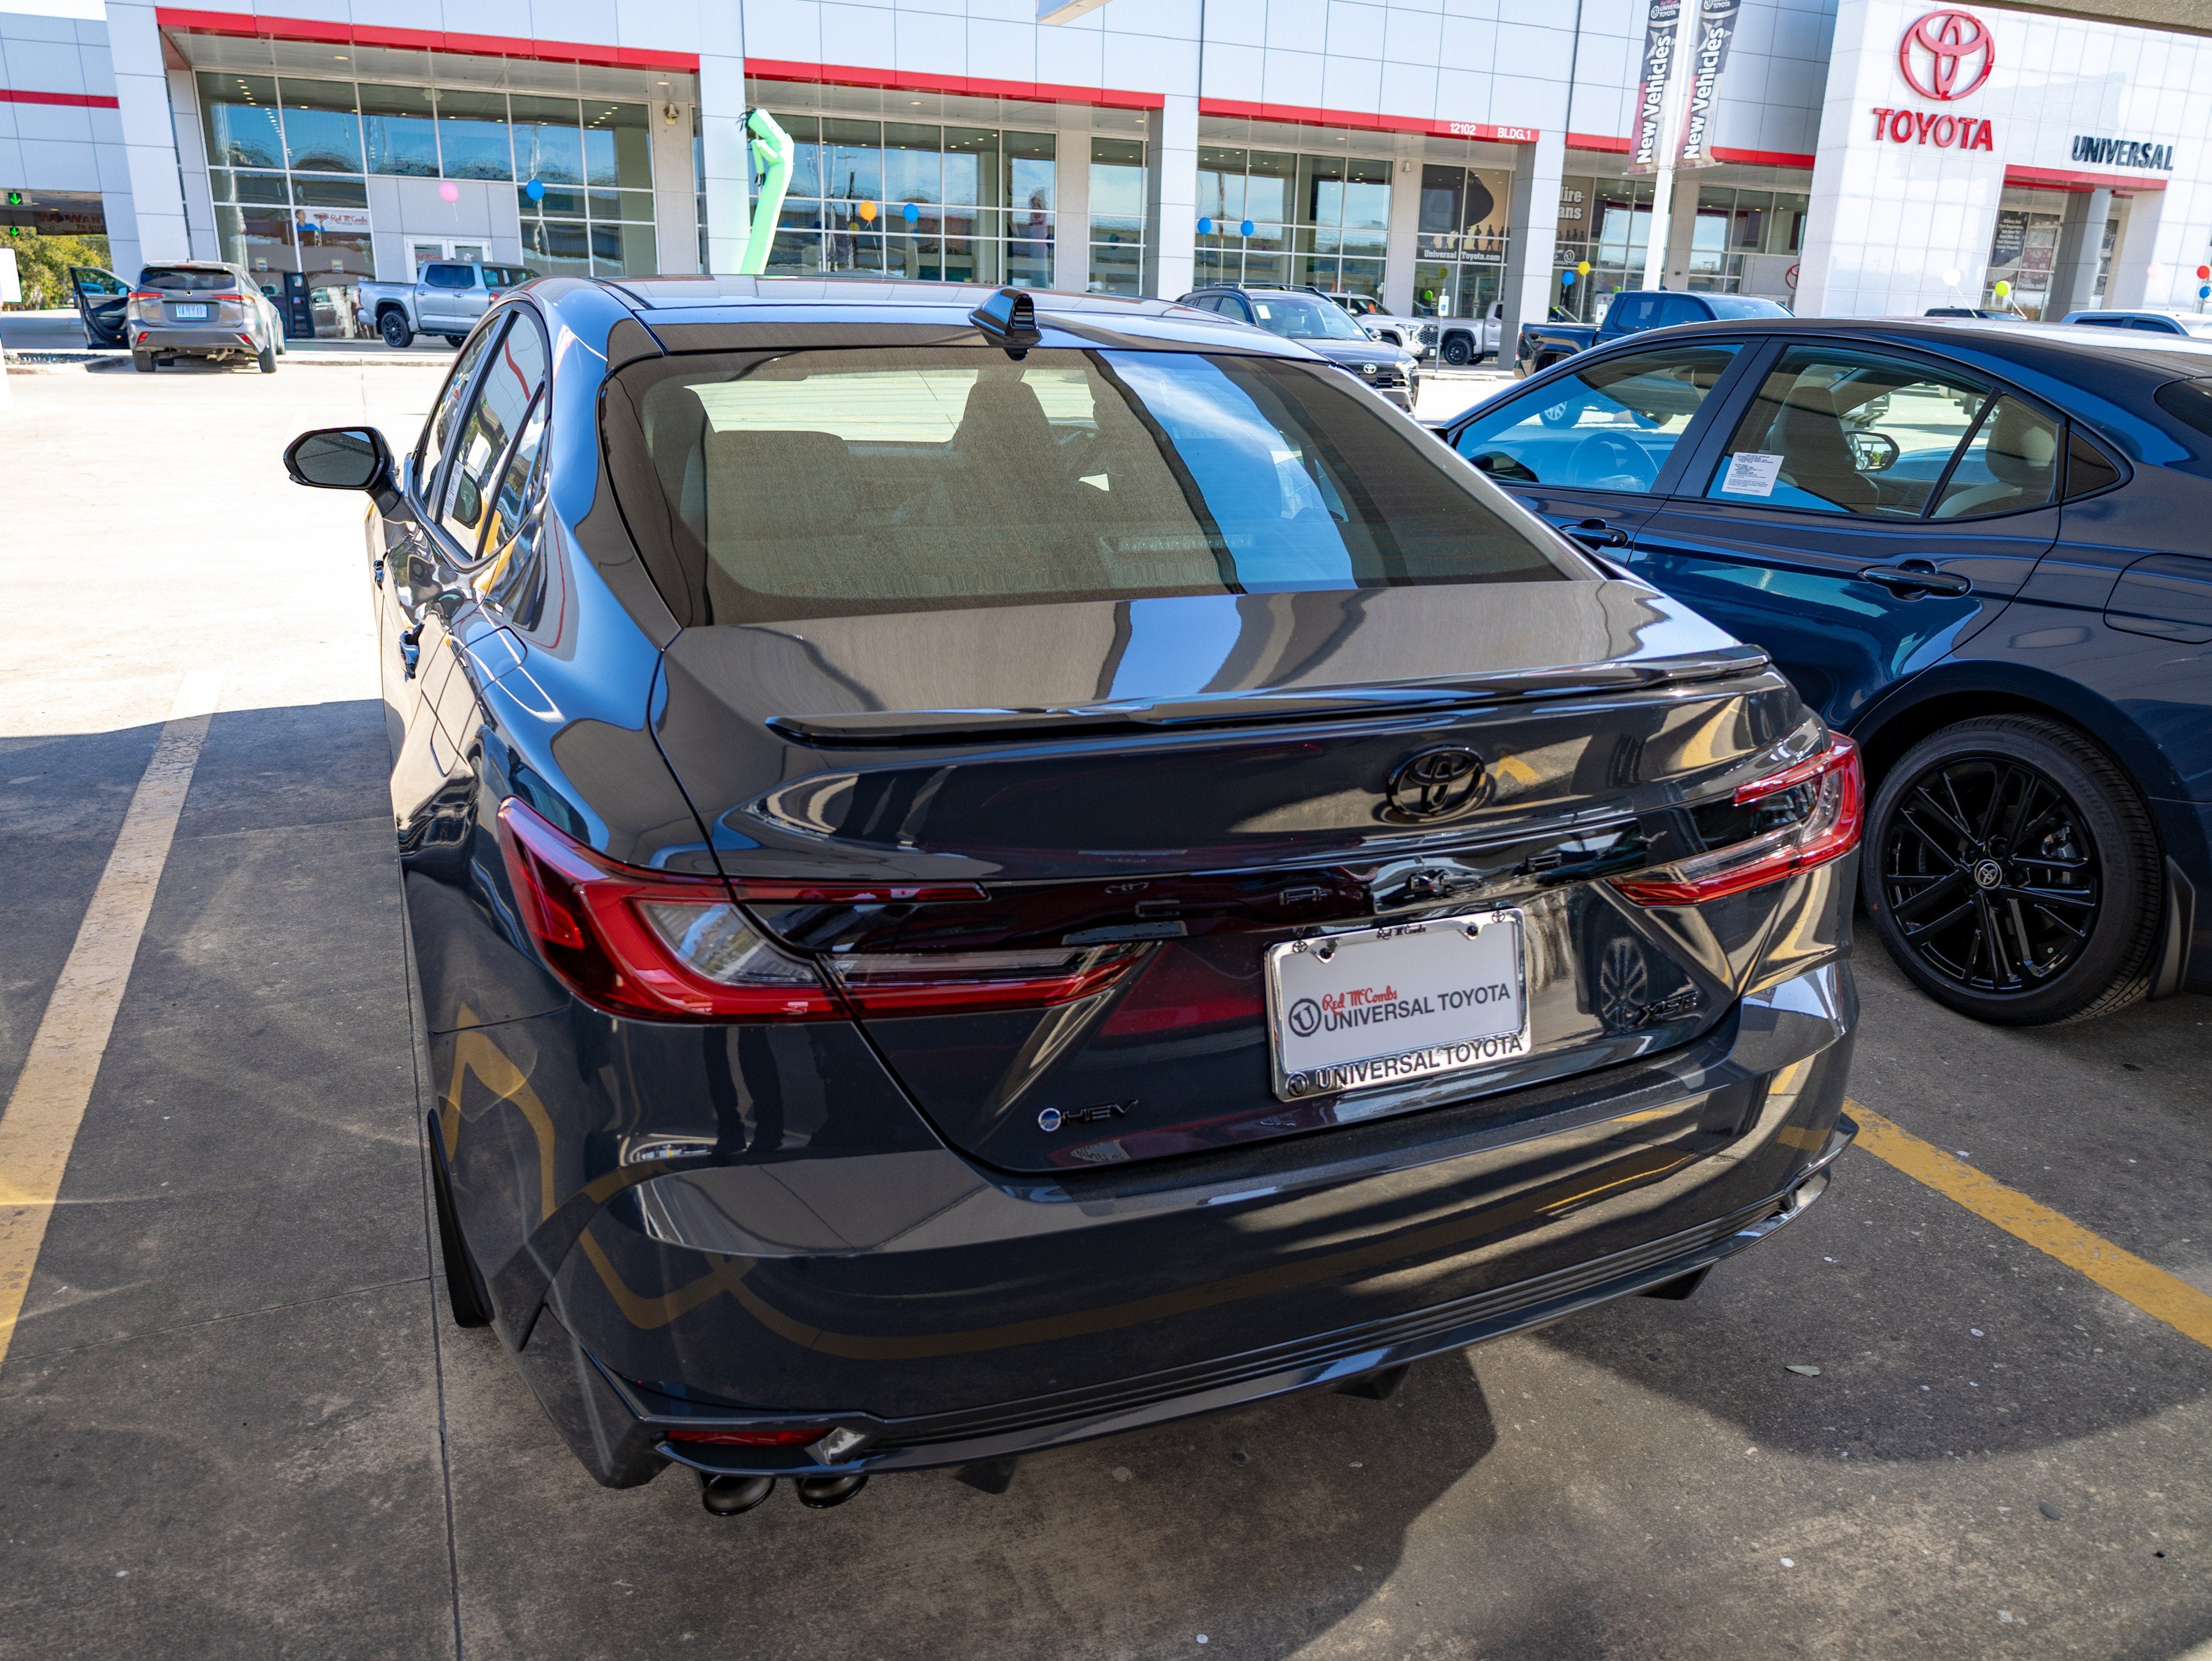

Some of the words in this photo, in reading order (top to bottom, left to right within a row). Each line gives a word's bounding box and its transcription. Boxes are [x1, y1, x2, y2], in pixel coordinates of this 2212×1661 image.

[1642, 35, 1671, 118] Vehicles
[1691, 27, 1725, 113] Vehicles
[1450, 123, 1476, 135] 12102
[1637, 121, 1657, 165] New
[1683, 116, 1705, 160] New
[1873, 108, 1993, 152] TOYOTA
[2072, 135, 2174, 171] UNIVERSAL
[1559, 206, 1582, 220] ans
[1423, 249, 1457, 259] Universal
[1461, 251, 1501, 262] Toyota.com
[1322, 993, 1345, 1015] Red
[1346, 985, 1397, 1007] McCombs
[1324, 997, 1435, 1031] UNIVERSAL
[1438, 983, 1510, 1011] TOYOTA
[1316, 1050, 1440, 1089] UNIVERSAL
[1442, 1032, 1522, 1065] TOYOTA
